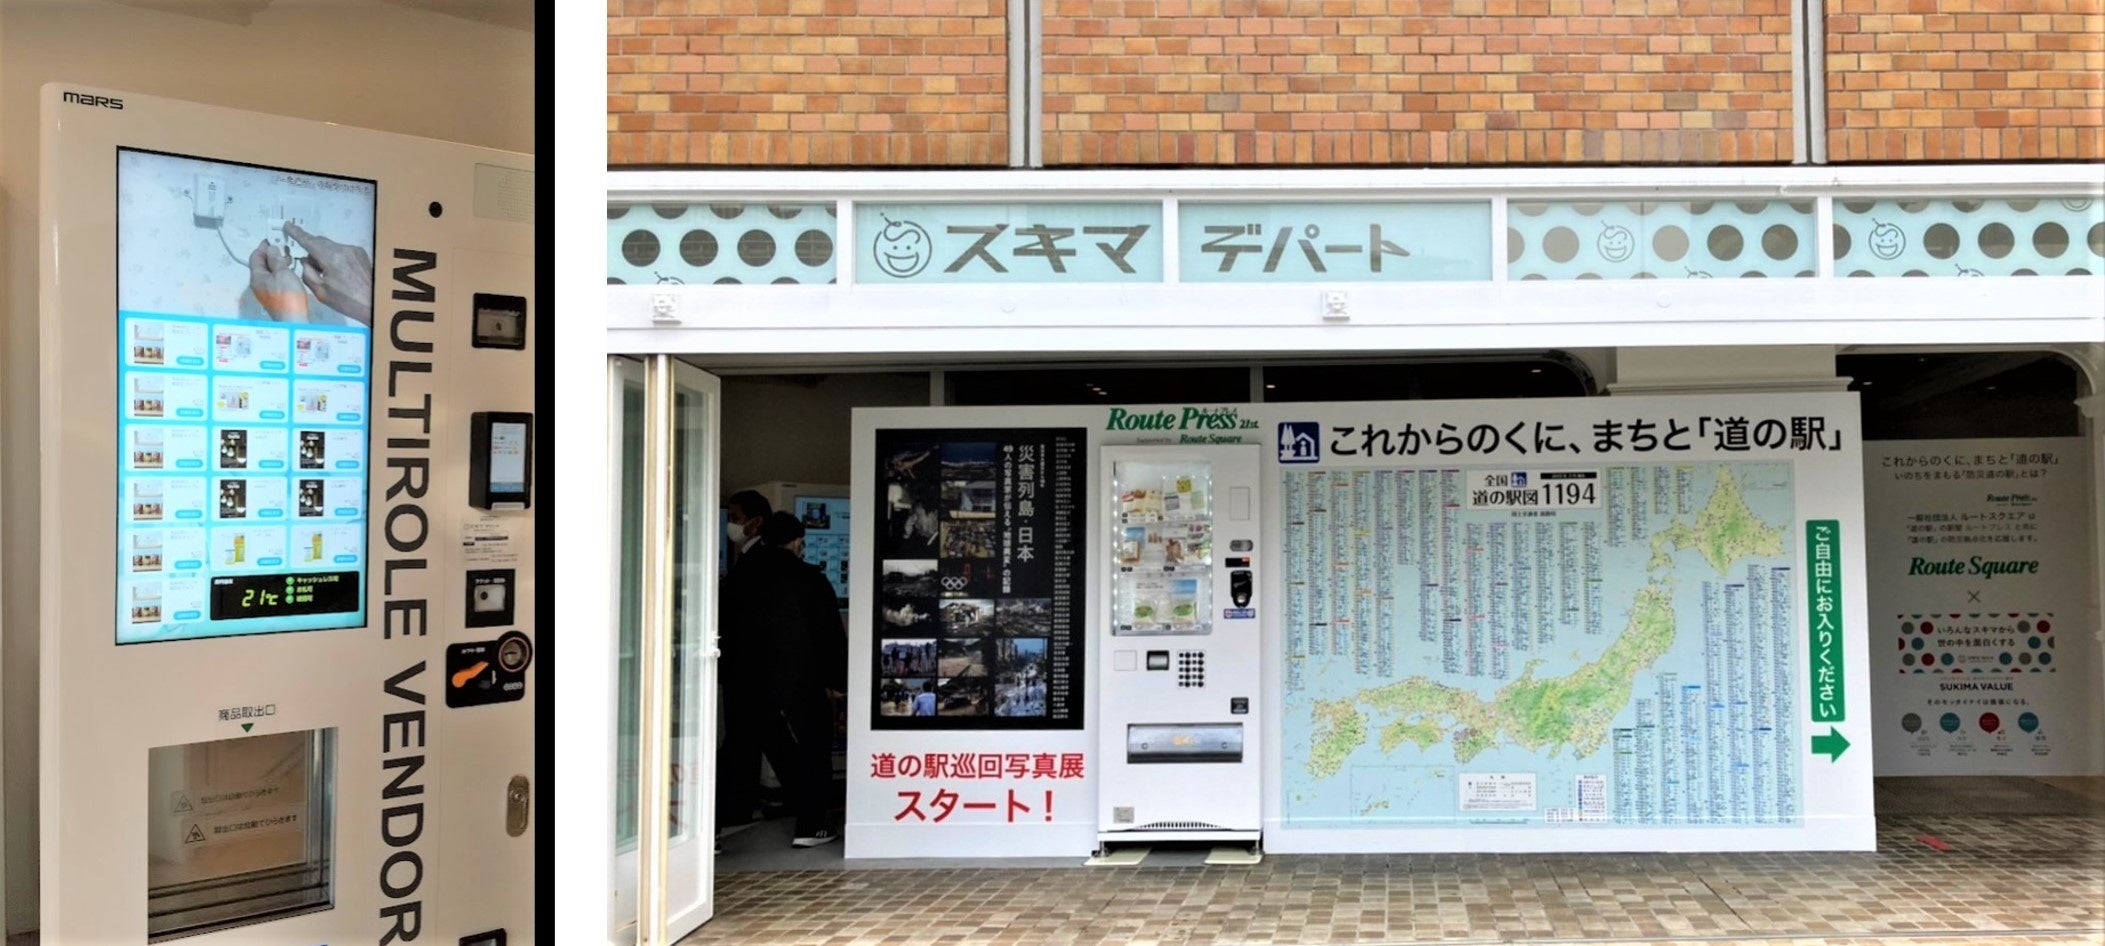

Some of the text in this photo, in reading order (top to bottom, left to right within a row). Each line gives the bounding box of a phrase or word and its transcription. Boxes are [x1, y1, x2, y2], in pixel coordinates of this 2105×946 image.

[943, 223, 1411, 274] スキマ デパート
[1106, 407, 1176, 430] Route
[1178, 407, 1238, 430] Press
[1179, 434, 1206, 445] Route
[1208, 434, 1243, 445] Square
[1329, 416, 1844, 458] これからのくに、まちと「道の駅」
[1485, 475, 1508, 487] 全国
[1017, 444, 1035, 563] 災害列島・日本
[1472, 482, 1596, 506] 道の駅図 1194
[1908, 556, 2039, 579] Route Square
[379, 248, 438, 946] MULTIROLE VENDOR
[1815, 525, 1837, 718] ご自由にお入りください
[1937, 625, 2015, 635] いろんなスキマから
[1940, 683, 2014, 691] SUKIMA VALUE
[217, 704, 277, 722] 商品取出口
[870, 752, 1085, 779] 道の駅巡回写真展
